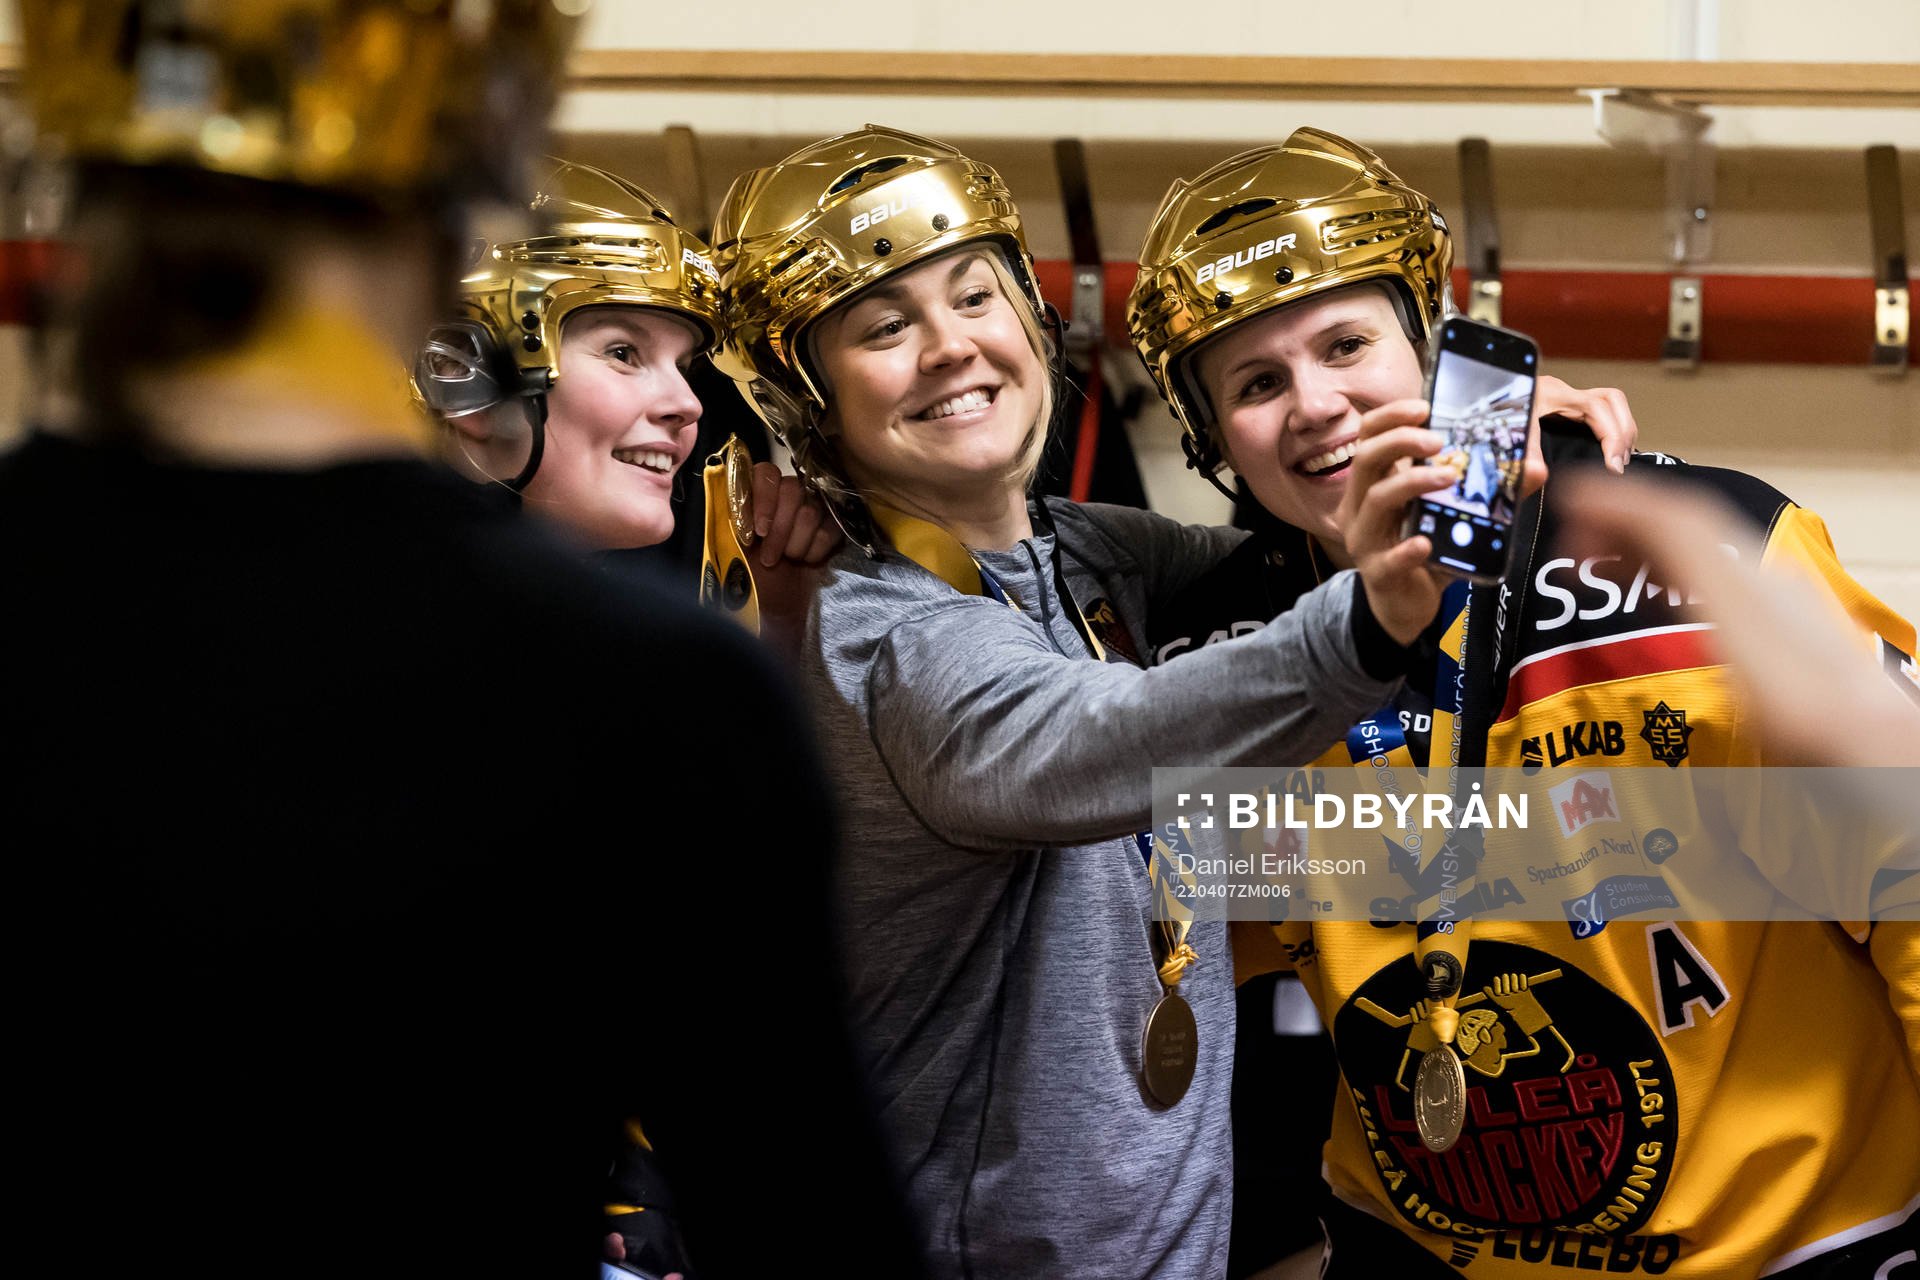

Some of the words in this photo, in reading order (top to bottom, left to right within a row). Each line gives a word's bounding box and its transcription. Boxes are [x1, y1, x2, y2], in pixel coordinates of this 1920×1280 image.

[851, 191, 925, 236] BAU
[682, 247, 721, 283] BAUE
[1196, 233, 1297, 287] BAUER
[1535, 550, 1705, 631] SSA
[1546, 720, 1626, 768] LKAB
[1560, 778, 1617, 833] MAX
[1526, 845, 1601, 886] Sparbanken
[1600, 837, 1636, 856] Nord
[1645, 921, 1731, 1038] A
[1374, 1053, 1623, 1132] LLEÅ
[1628, 1058, 1665, 1129] 1977
